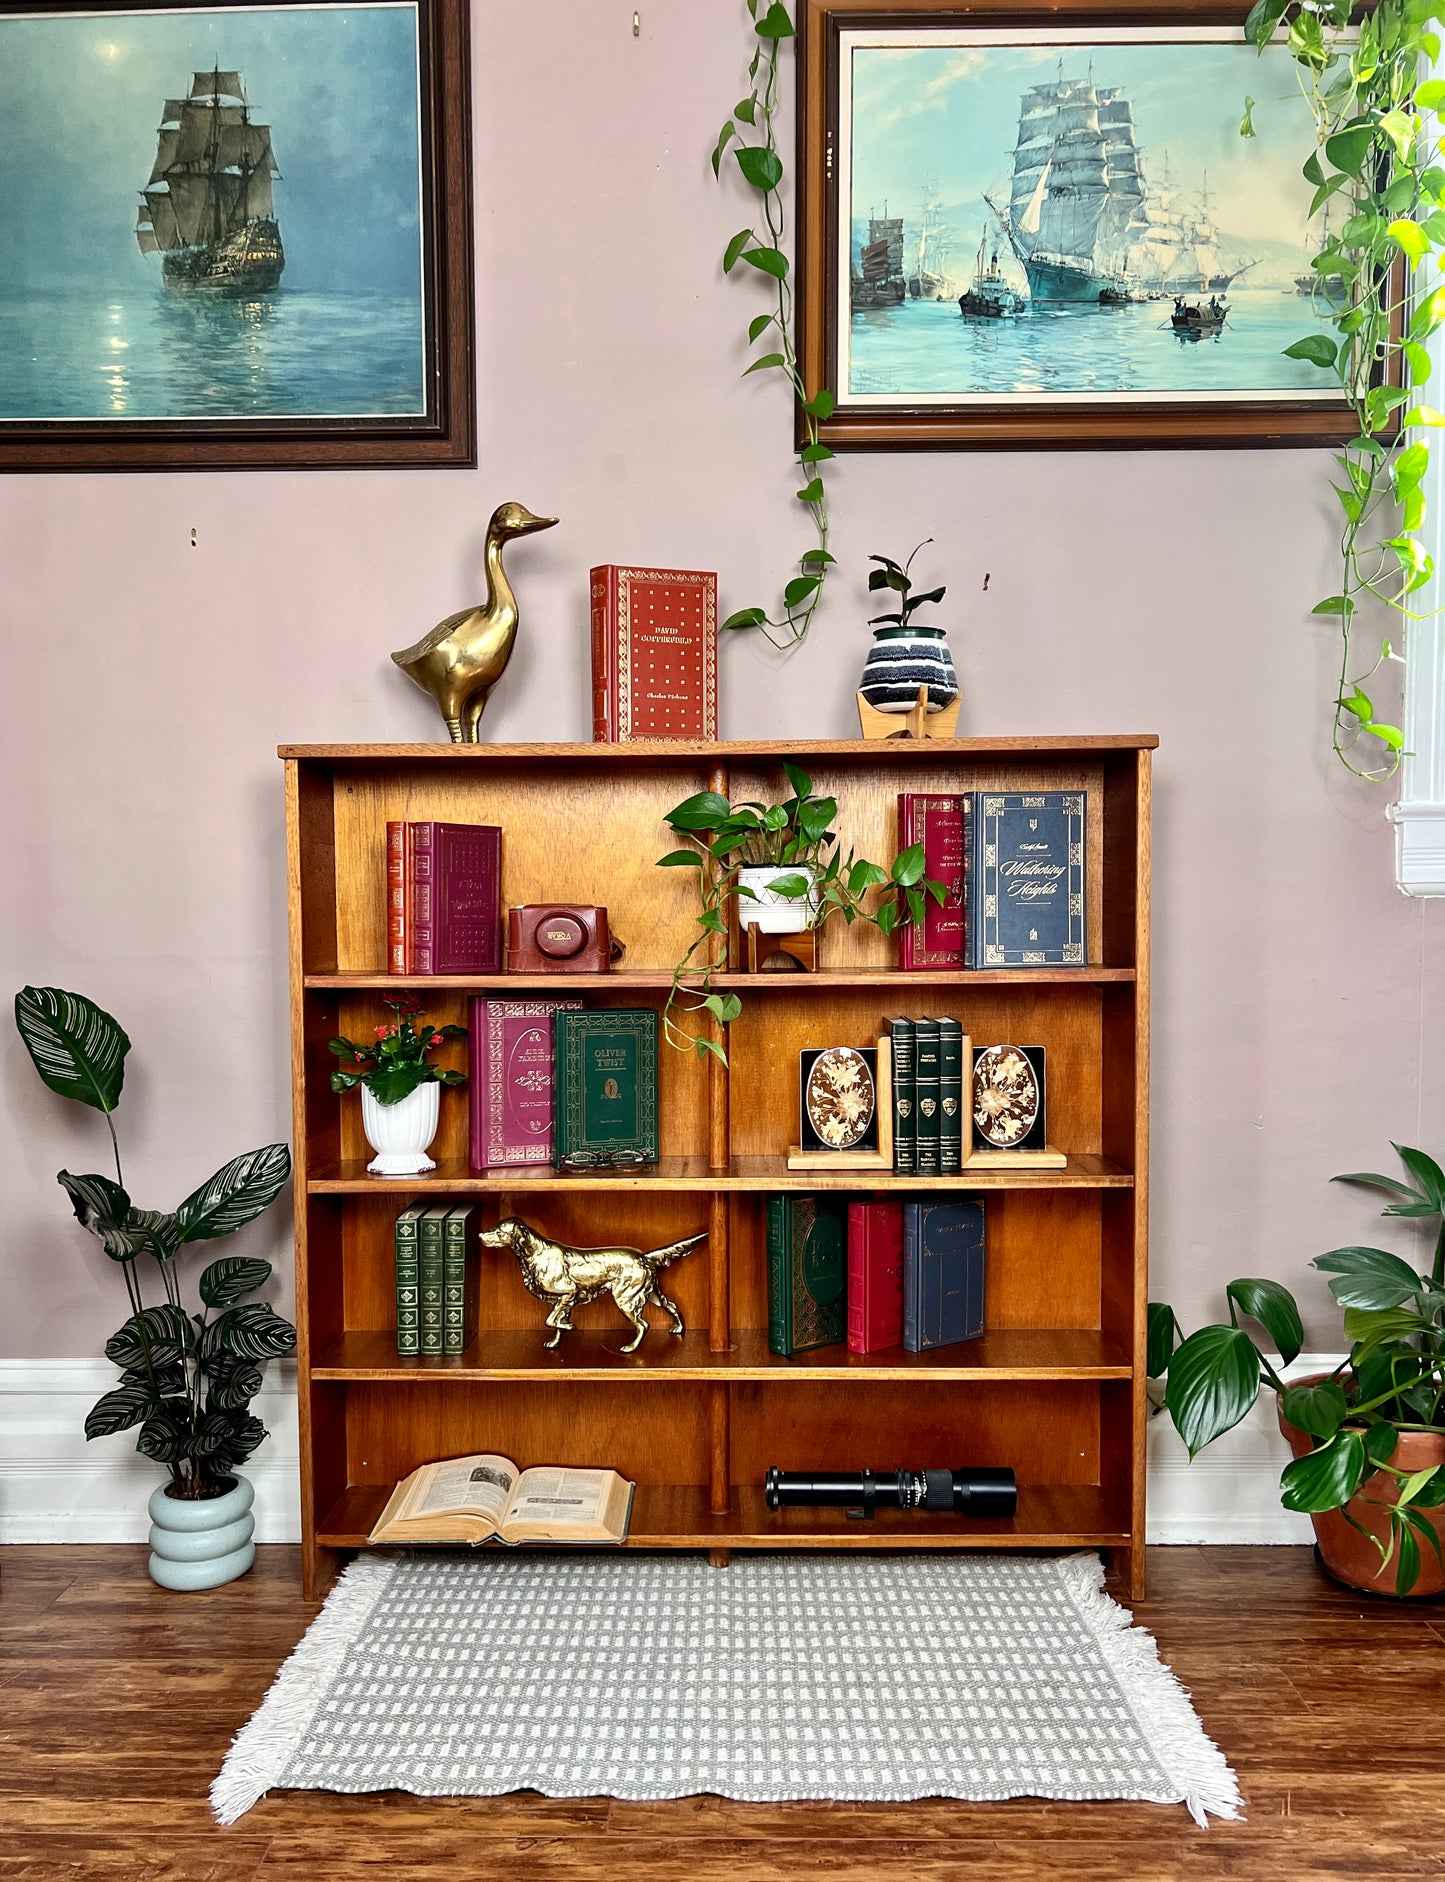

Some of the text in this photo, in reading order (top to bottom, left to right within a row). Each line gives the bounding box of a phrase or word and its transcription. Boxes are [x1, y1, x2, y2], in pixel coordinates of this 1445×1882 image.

[655, 626, 678, 634] DAVID
[641, 634, 692, 644] COPPERFIELD
[1000, 860, 1066, 880] Wuthering
[1007, 879, 1057, 900] Heights
[594, 1048, 626, 1057] OLIVER
[597, 1058, 624, 1067] TWIST
